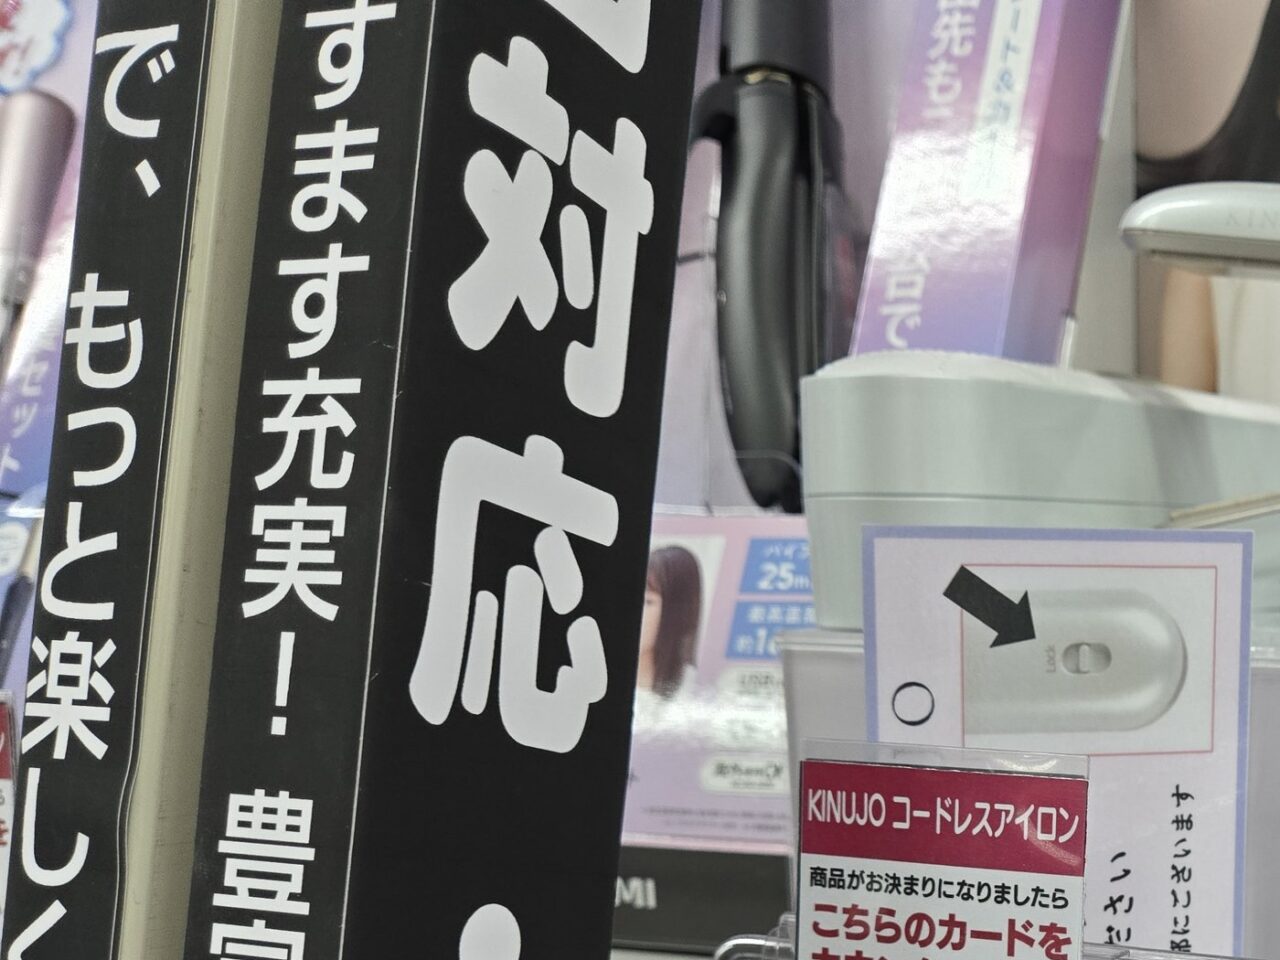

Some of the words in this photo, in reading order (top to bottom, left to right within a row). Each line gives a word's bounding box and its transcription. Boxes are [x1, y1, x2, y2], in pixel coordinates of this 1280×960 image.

[807, 788, 886, 828] KINUJO
[892, 797, 1079, 844] コードレスアイロン
[615, 876, 657, 909] MI
[809, 866, 1070, 910] 商品がお決まりになりましたら
